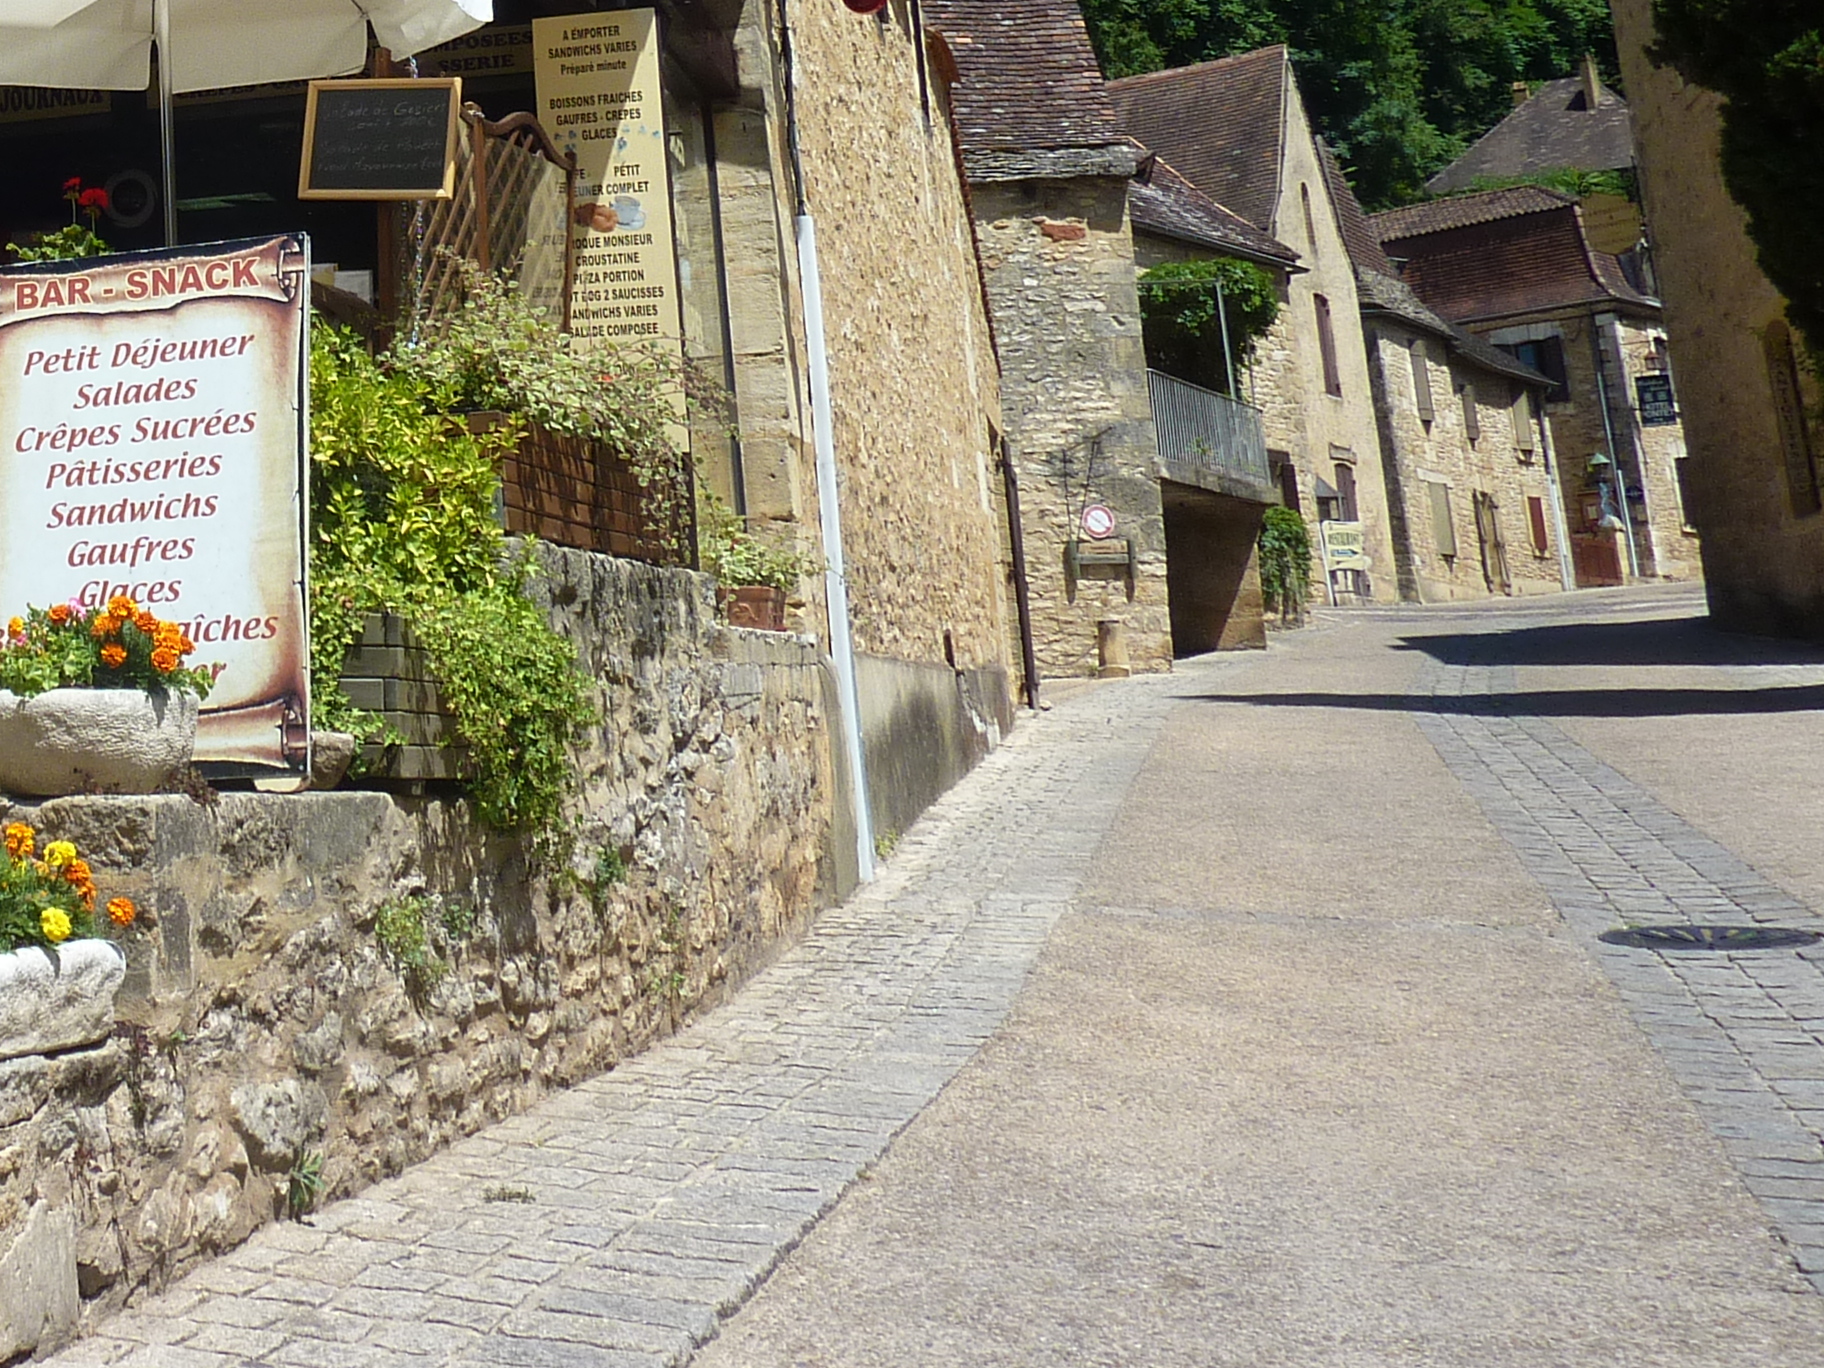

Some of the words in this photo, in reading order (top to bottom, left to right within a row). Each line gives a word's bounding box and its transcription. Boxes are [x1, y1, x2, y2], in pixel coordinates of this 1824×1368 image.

[562, 30, 569, 41] A
[548, 44, 602, 59] SANDWICHS
[604, 40, 637, 54] VARIES
[596, 60, 627, 72] minute
[549, 95, 596, 110] BOISSONS
[597, 90, 644, 105] FRAICHES
[556, 112, 598, 126] GAUFRES
[605, 107, 642, 121] CREPES
[581, 127, 617, 140] GLACES
[606, 180, 650, 195] COMPLET
[603, 233, 654, 247] MONSIEUR
[575, 252, 641, 267] CROUSTATINE
[14, 276, 92, 310] BAR
[127, 257, 259, 301] SNACK
[603, 269, 645, 283] PORTION
[603, 288, 611, 301] 2
[612, 285, 665, 300] SAUCISSES
[623, 303, 659, 318] VARIES
[606, 322, 659, 337] COMPOSEE
[23, 347, 101, 376] Petit
[111, 334, 255, 370] Déjeuner
[72, 376, 198, 410] Salades
[15, 421, 121, 454] Crêpes
[131, 408, 256, 444] Sucrées
[45, 452, 223, 490] Pâtisseries
[46, 493, 219, 531] Sandwichs
[67, 536, 195, 569] Gaufres
[179, 613, 278, 643] aîches
